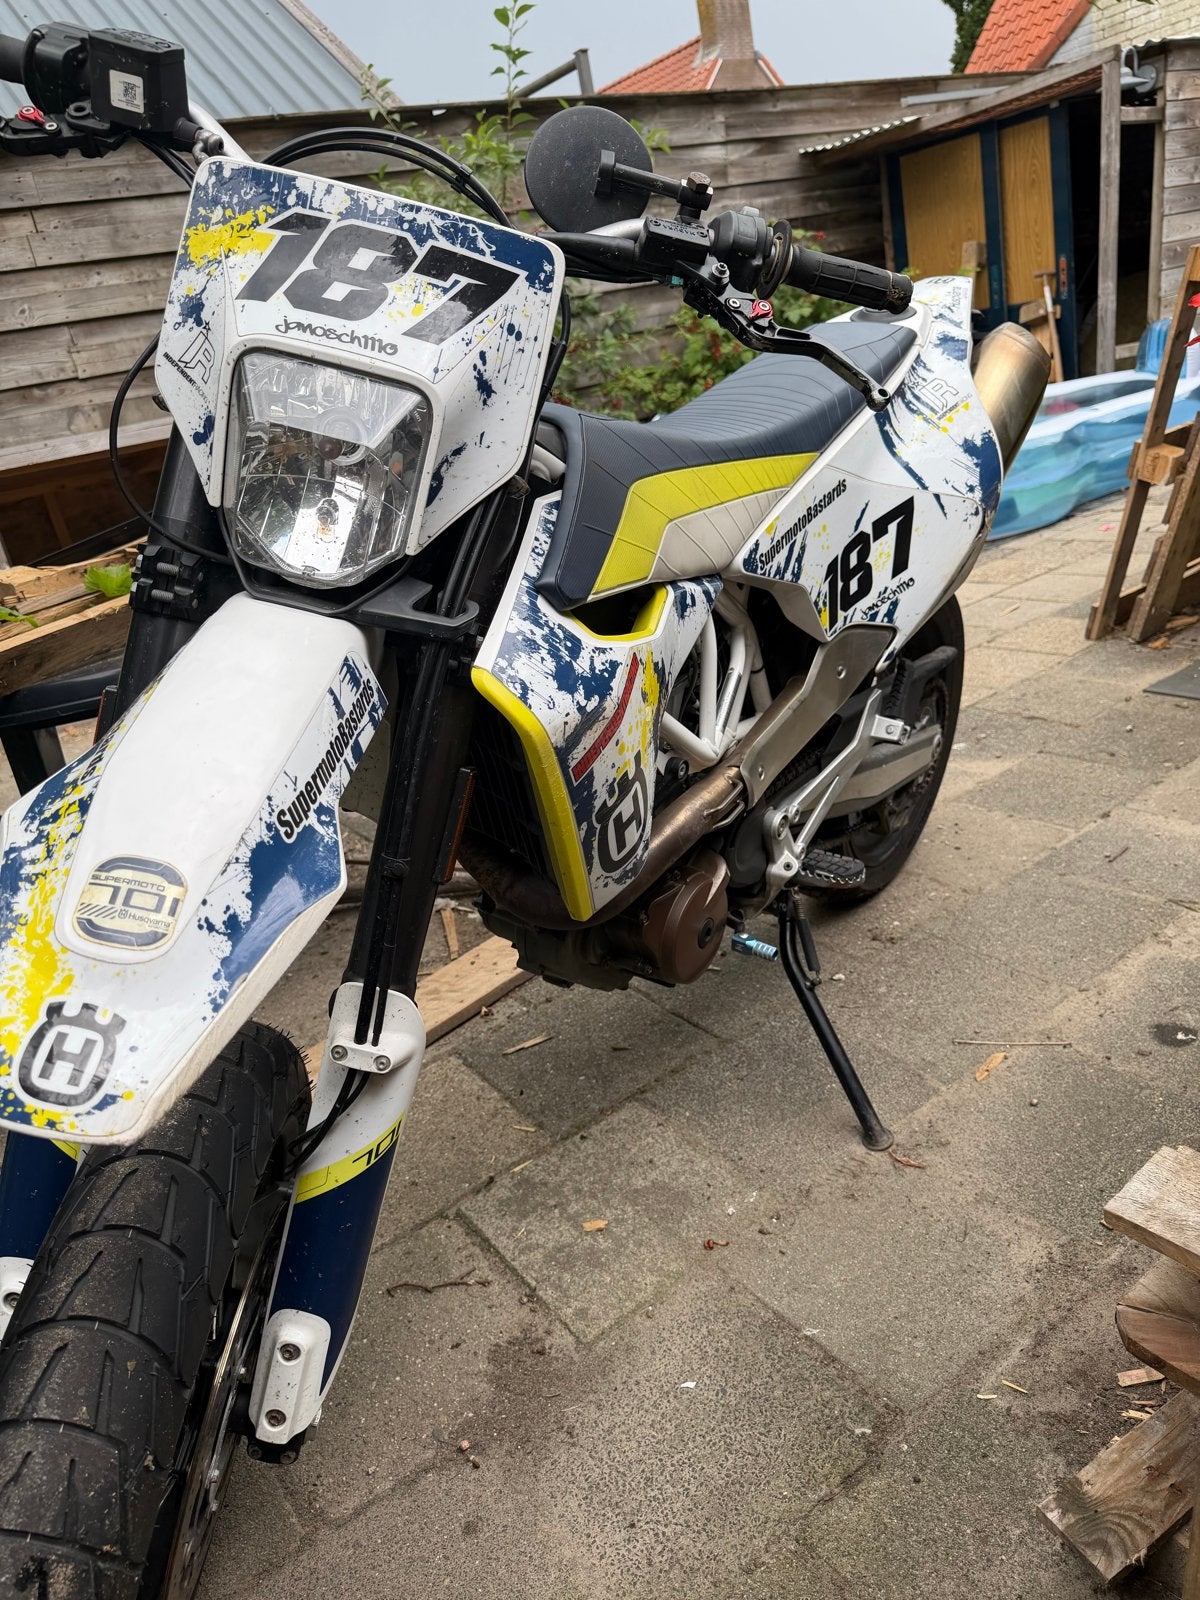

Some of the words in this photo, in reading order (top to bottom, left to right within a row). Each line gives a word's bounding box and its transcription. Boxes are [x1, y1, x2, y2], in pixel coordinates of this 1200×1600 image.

[234, 211, 521, 346] 187
[758, 478, 848, 572] SupermotoBastards
[823, 495, 915, 634] 187
[276, 678, 375, 840] SupermotoBastards
[88, 882, 181, 918] 701
[91, 873, 166, 893] SUPERMOTO
[128, 912, 171, 928] Husqvarna
